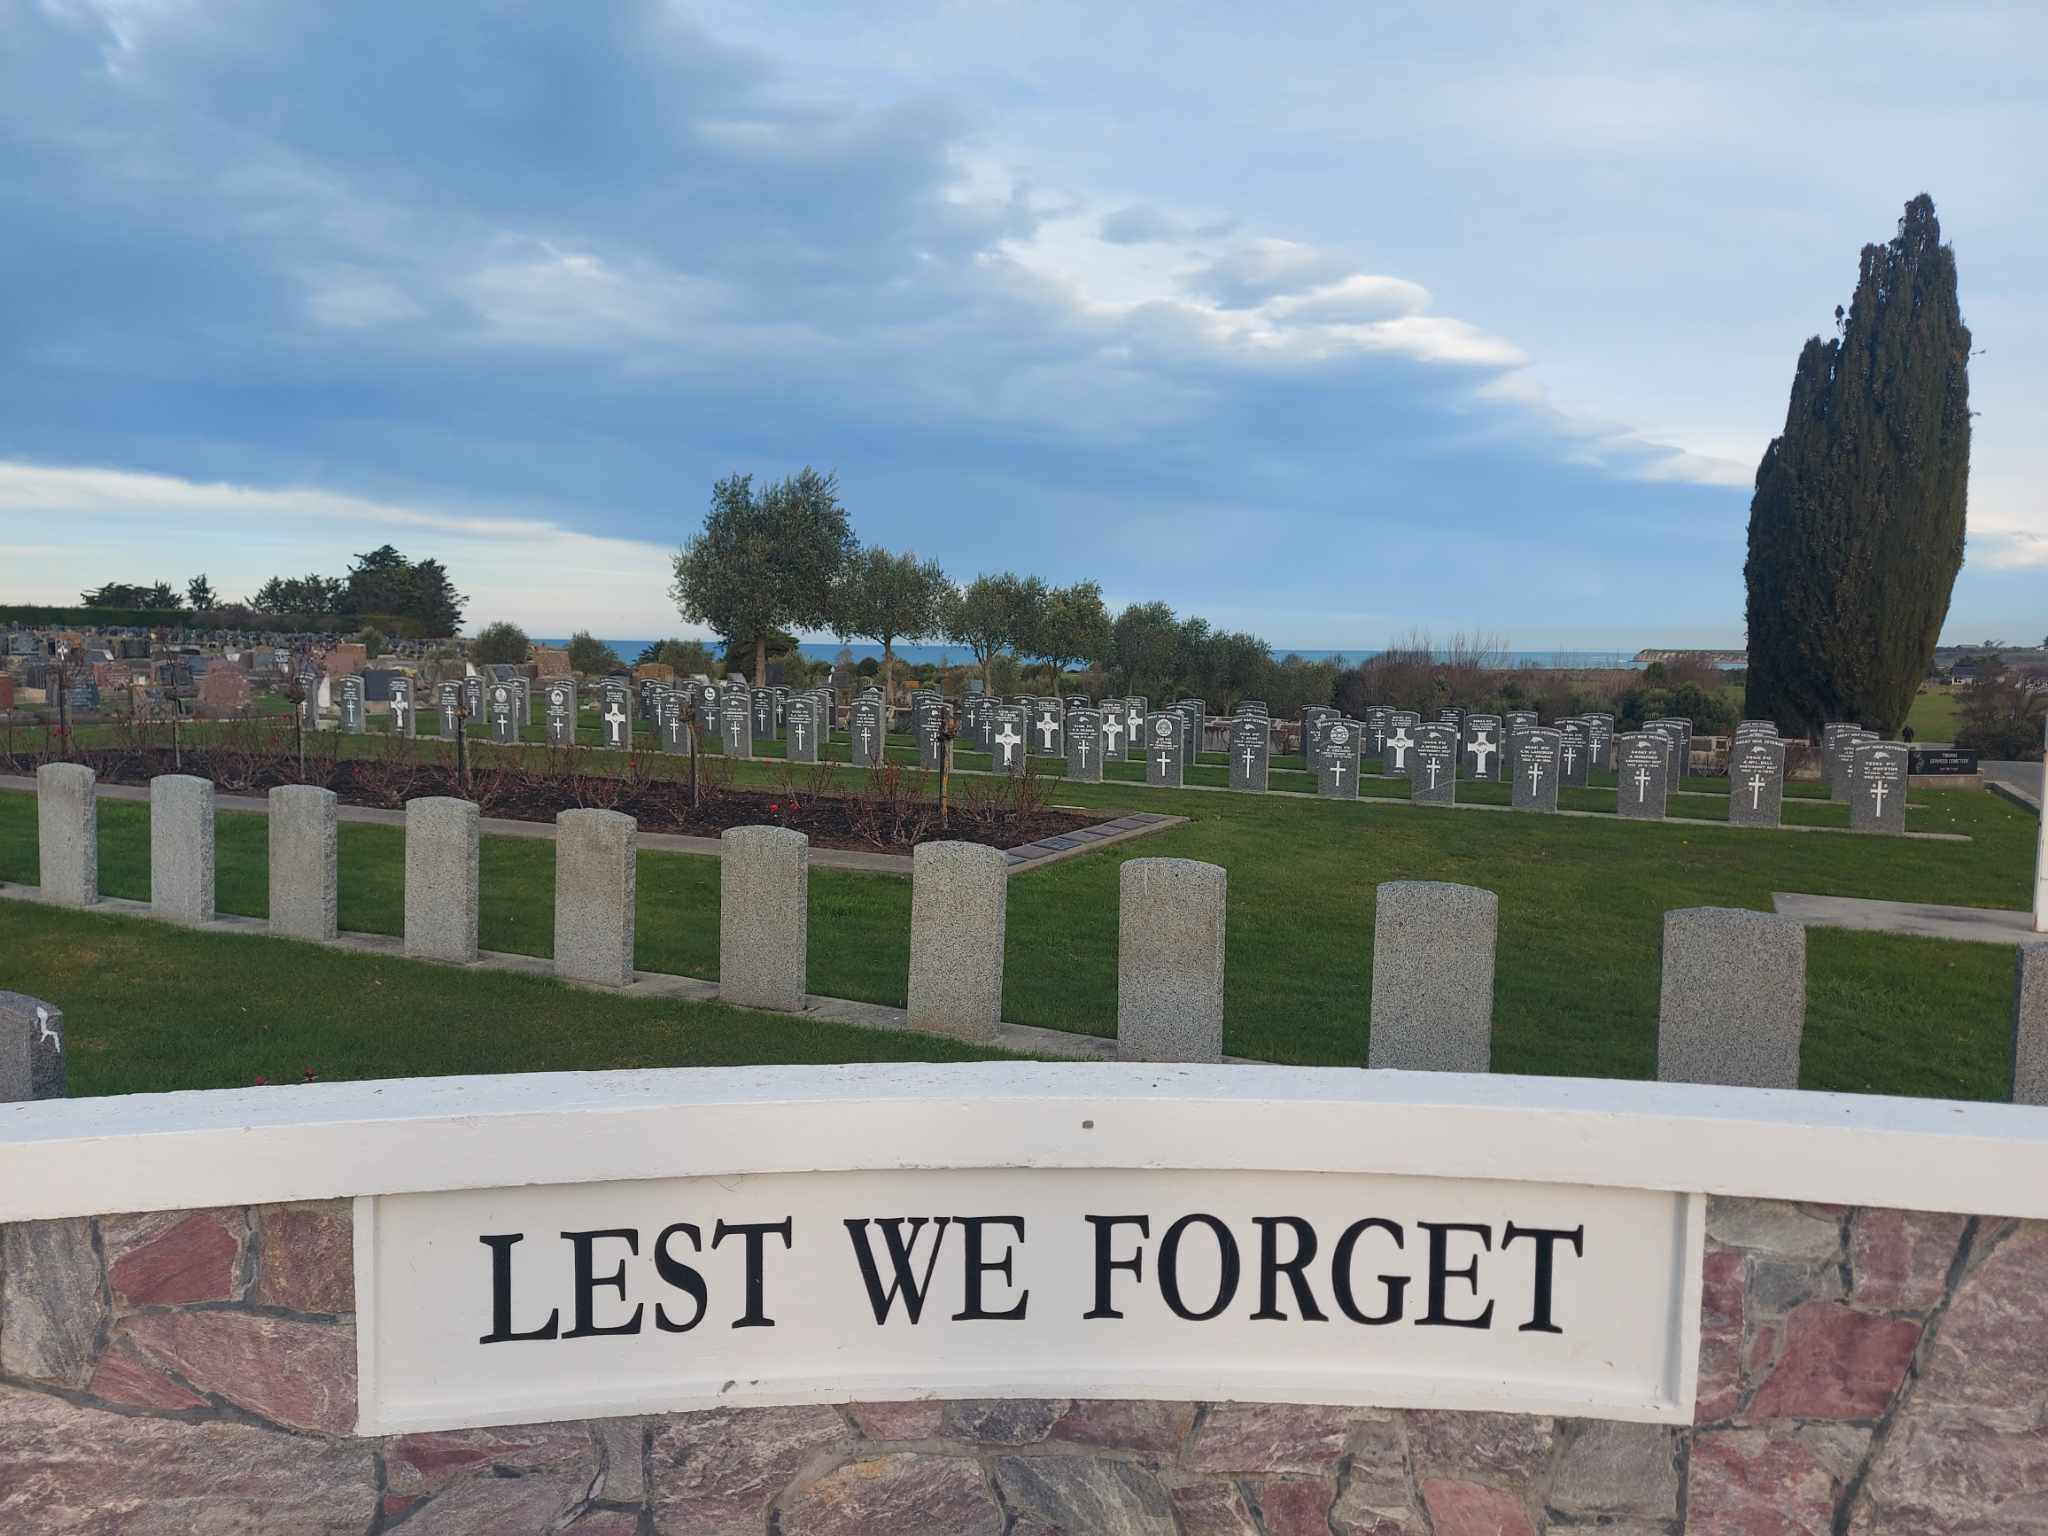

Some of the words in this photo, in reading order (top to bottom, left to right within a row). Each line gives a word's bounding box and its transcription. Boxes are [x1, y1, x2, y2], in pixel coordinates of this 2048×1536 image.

[479, 1215, 793, 1345] LEST
[843, 1214, 1029, 1326] WE
[1082, 1213, 1585, 1334] FORGET
